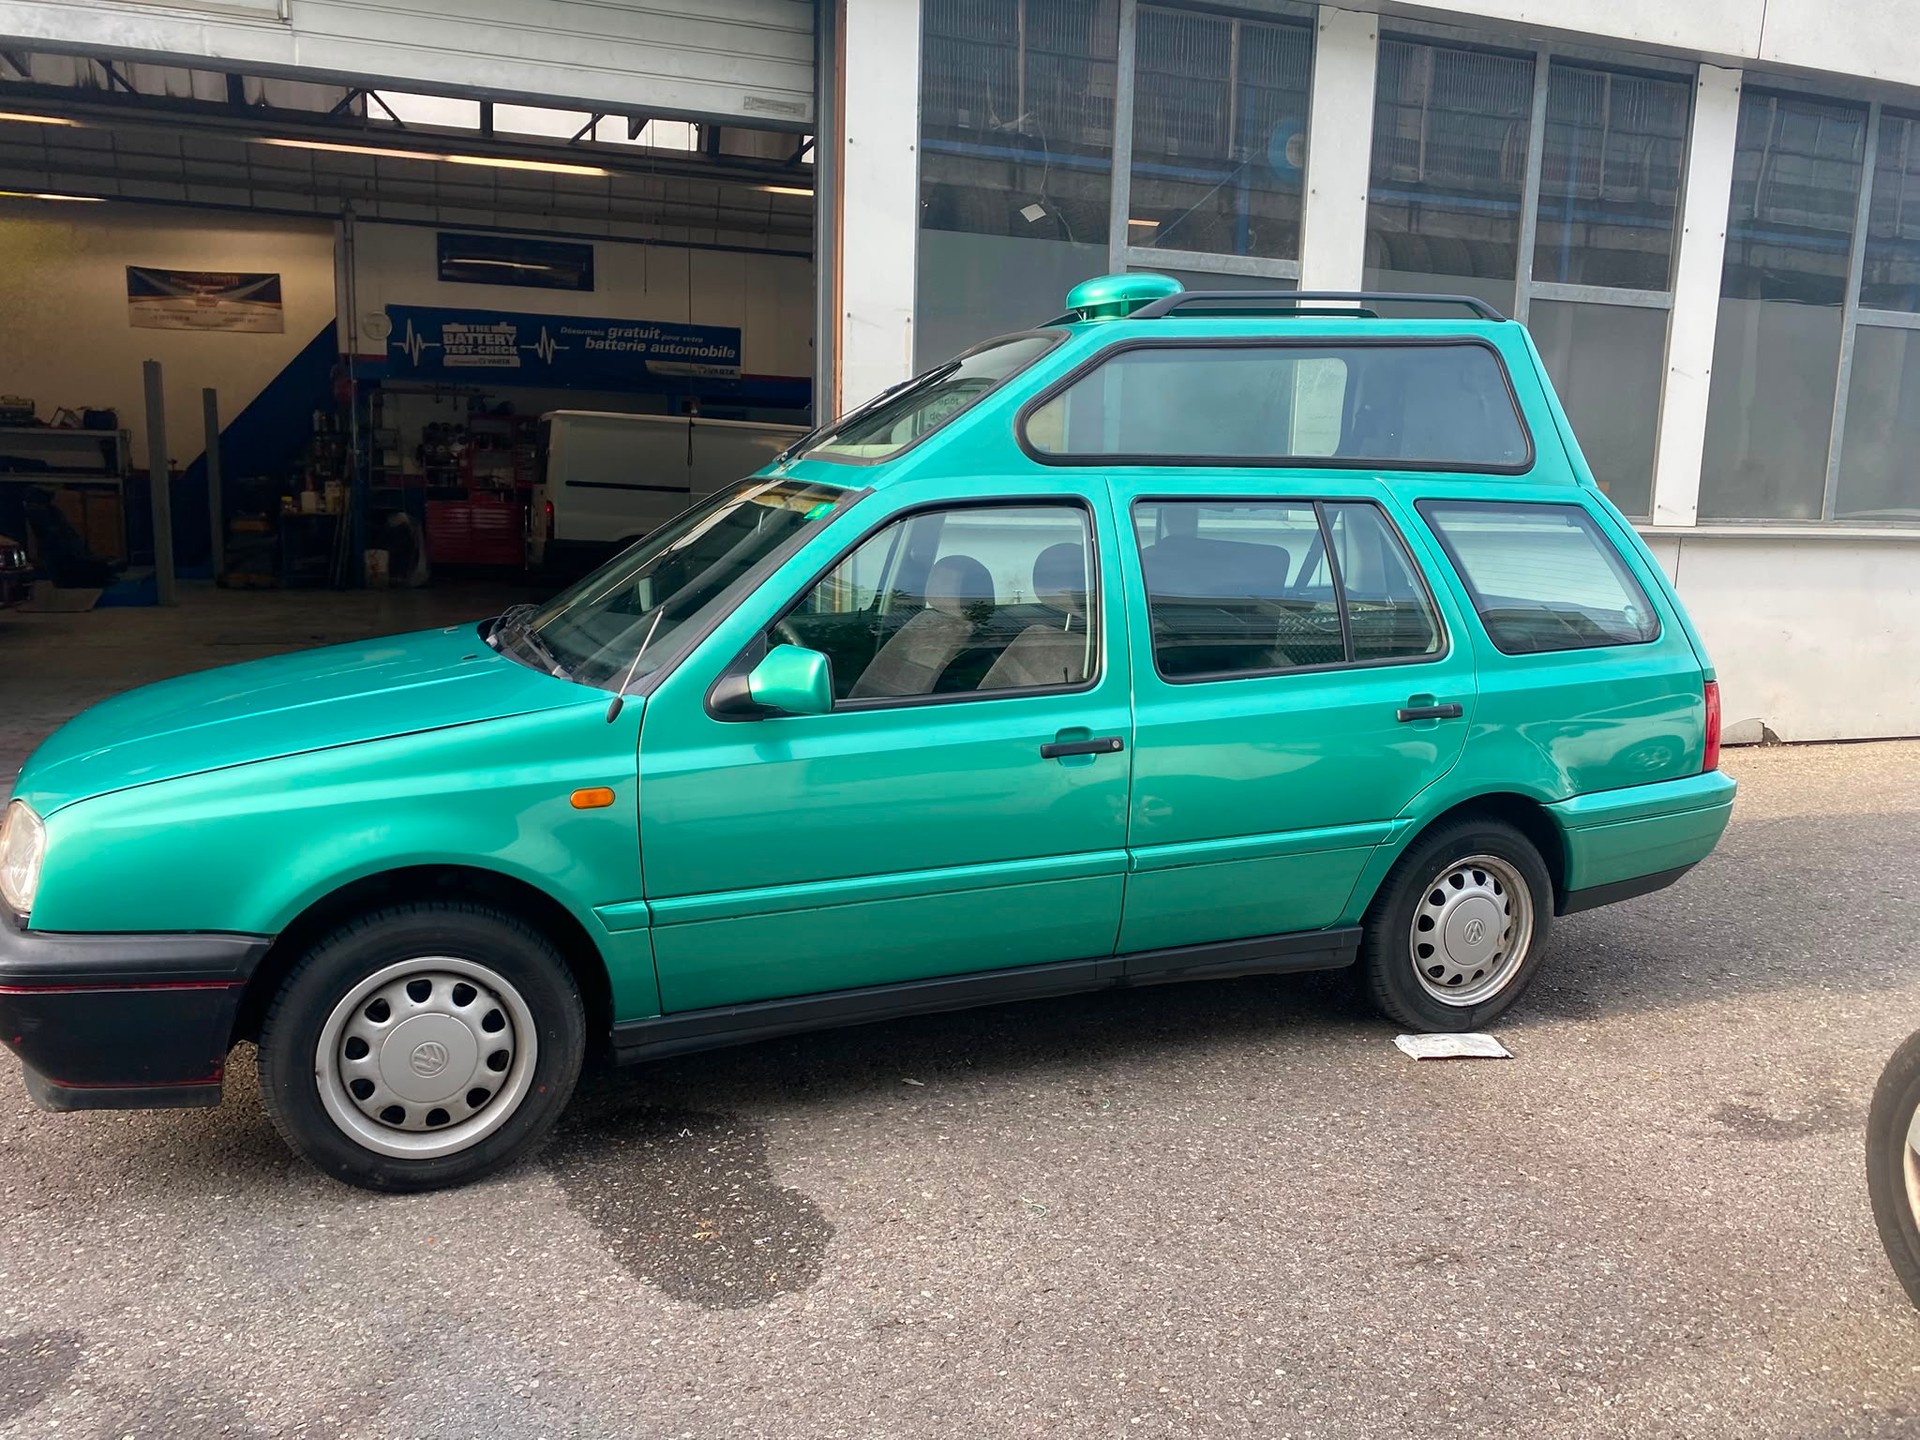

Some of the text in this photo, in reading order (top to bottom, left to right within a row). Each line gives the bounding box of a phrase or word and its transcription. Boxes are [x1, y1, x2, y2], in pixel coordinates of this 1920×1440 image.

[443, 333, 517, 345] BATTERY
[608, 327, 661, 340] gratuit
[444, 345, 517, 355] TEST-CHECK
[585, 337, 736, 358] batterie automobile
